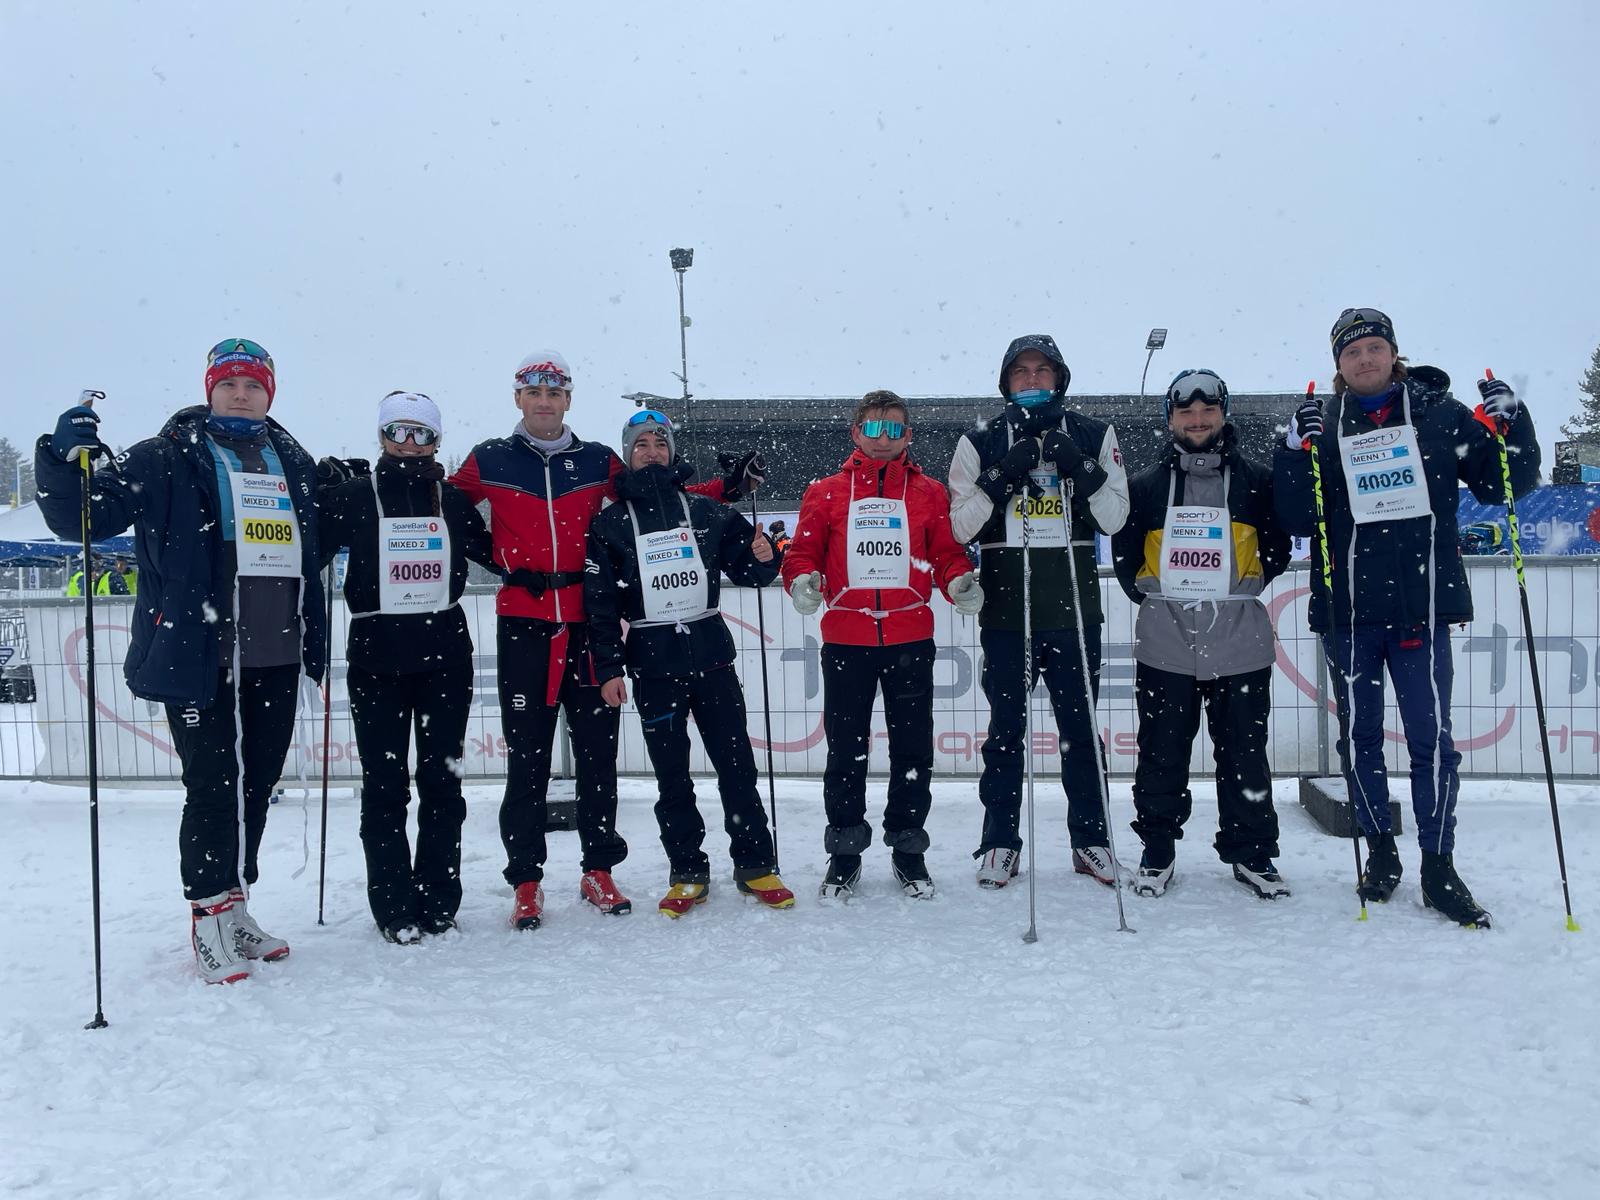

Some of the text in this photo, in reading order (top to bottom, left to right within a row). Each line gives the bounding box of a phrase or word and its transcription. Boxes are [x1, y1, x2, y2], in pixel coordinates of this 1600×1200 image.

[1351, 435, 1386, 447] sport
[1353, 452, 1379, 463] MENN
[243, 478, 277, 488] SpareBank
[1357, 469, 1413, 492] 40026
[243, 498, 269, 506] MIXED
[858, 502, 885, 511] sport
[1176, 511, 1206, 520] sport
[245, 522, 292, 541] 40089
[392, 522, 428, 531] SpareBank
[646, 533, 680, 545] SpareBank
[856, 541, 902, 557] 40026
[648, 551, 672, 562] MIXED
[1169, 551, 1220, 568] 40026
[390, 562, 442, 581] 40089
[651, 570, 698, 591] 40089
